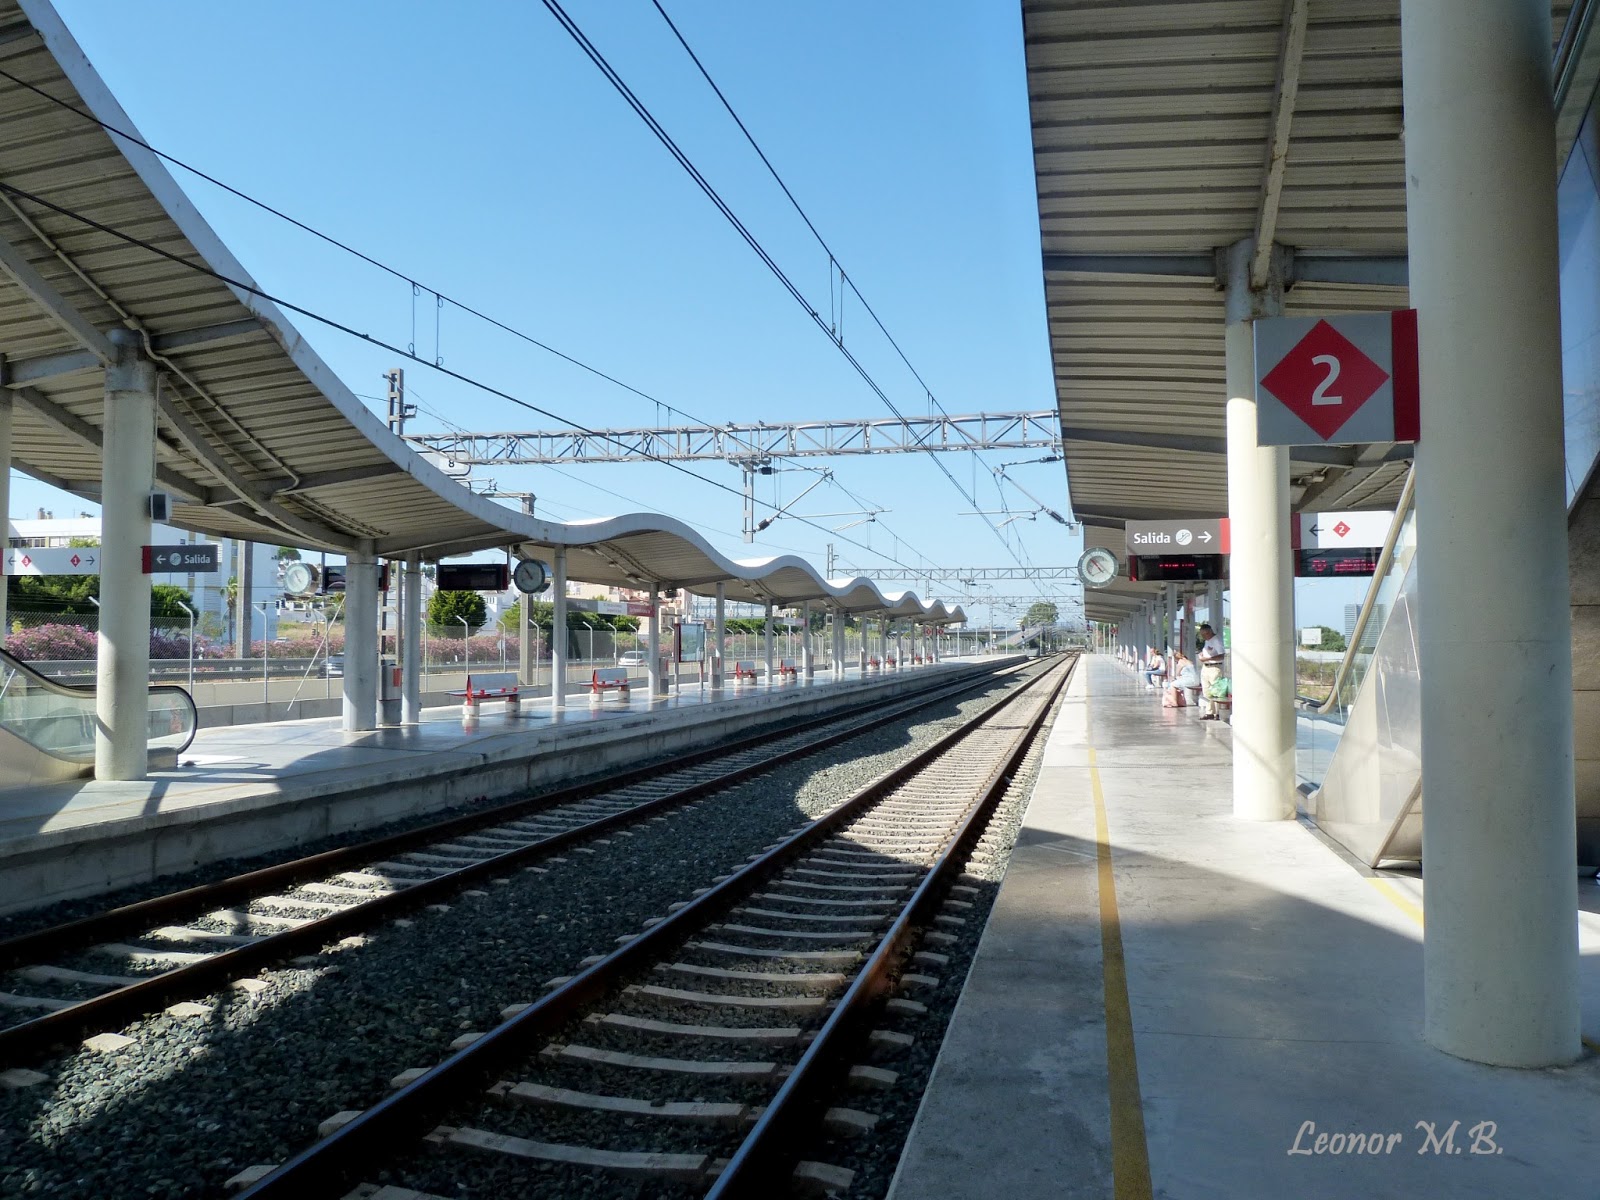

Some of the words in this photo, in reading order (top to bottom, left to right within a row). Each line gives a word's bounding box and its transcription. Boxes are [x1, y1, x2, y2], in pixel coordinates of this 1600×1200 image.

[1311, 354, 1343, 406] 2
[1338, 525, 1345, 534] 2
[1133, 532, 1171, 544] Salida
[184, 554, 211, 564] Salida
